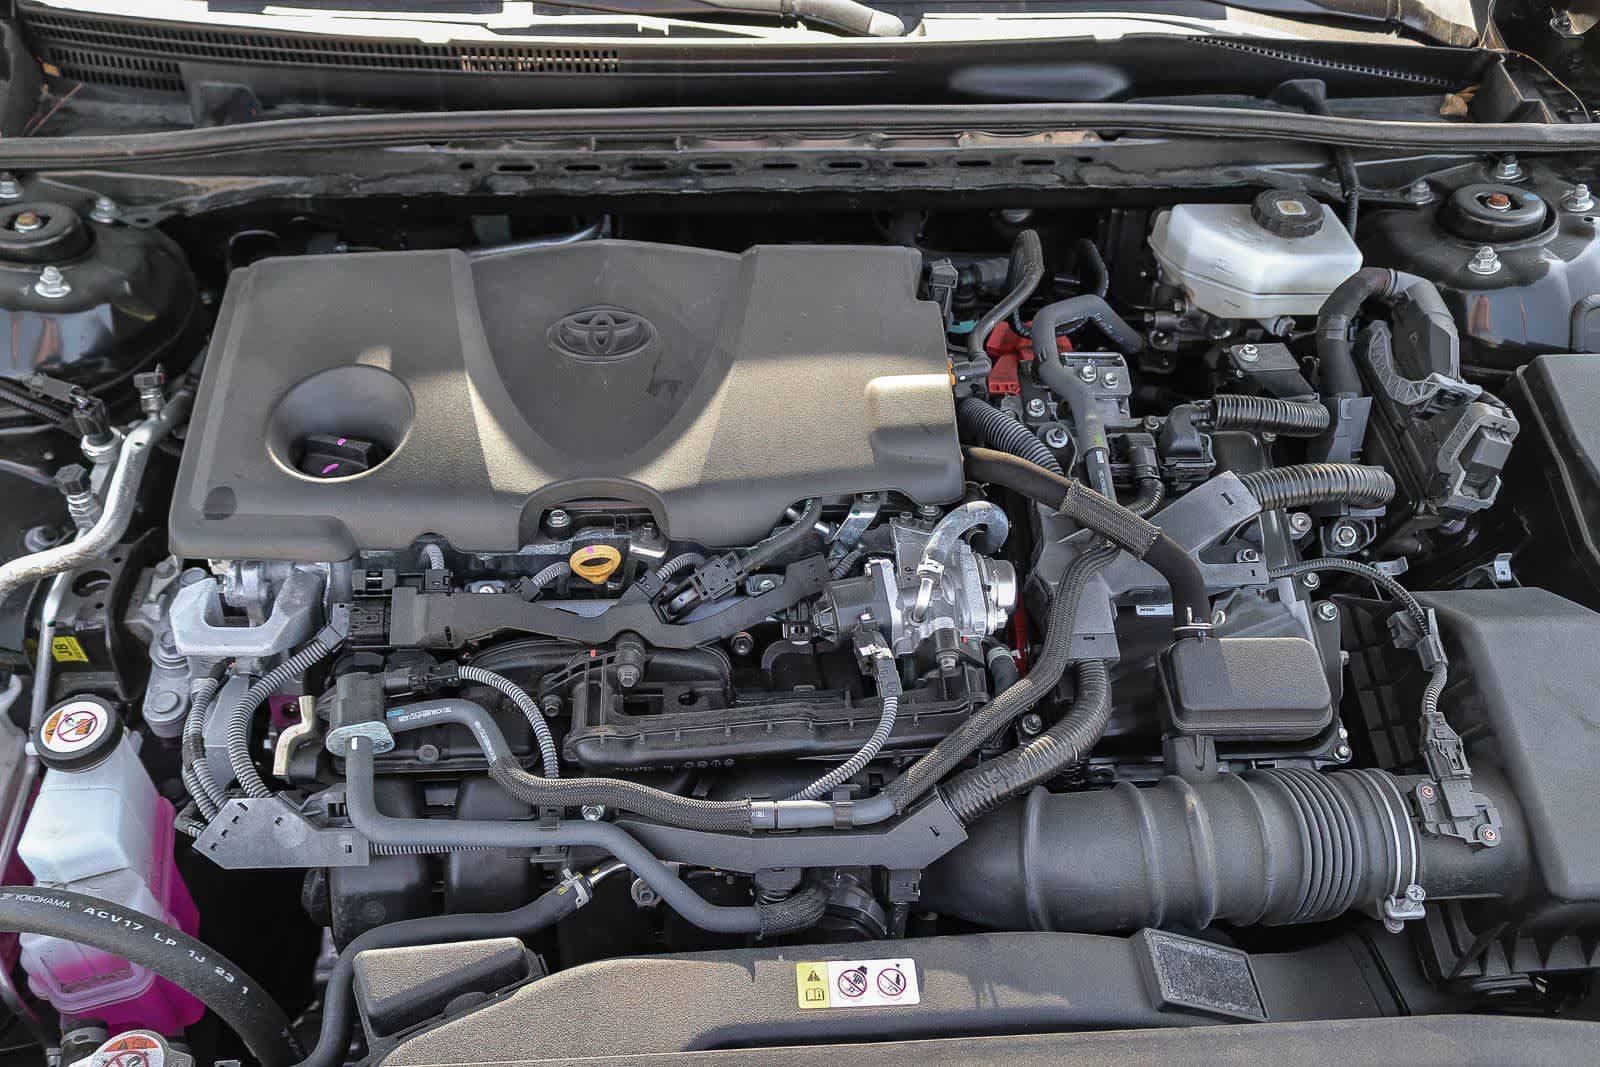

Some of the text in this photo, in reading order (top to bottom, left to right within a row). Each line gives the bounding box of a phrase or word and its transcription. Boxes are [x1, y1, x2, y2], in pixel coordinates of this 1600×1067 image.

[15, 893, 249, 995] YOKOHAMA ACV17 LP 1J 23 1
